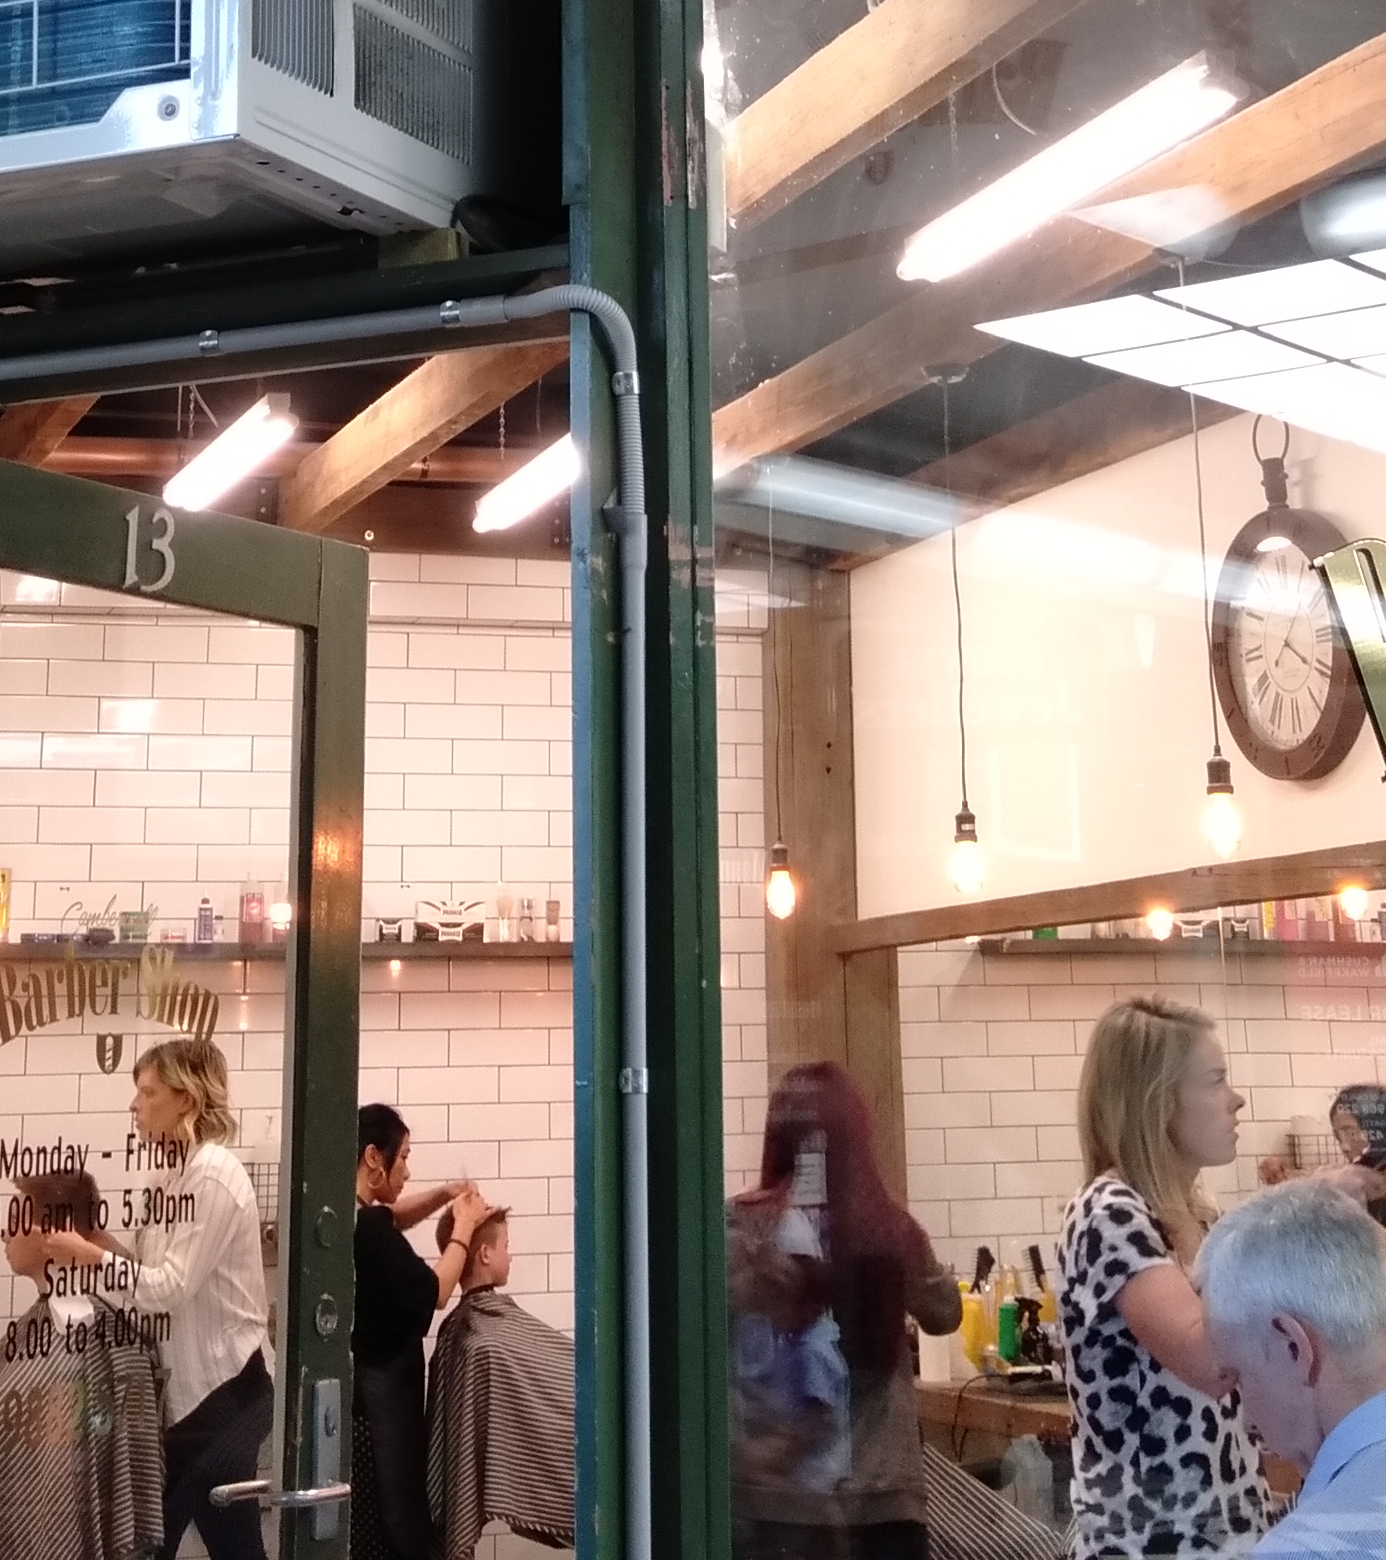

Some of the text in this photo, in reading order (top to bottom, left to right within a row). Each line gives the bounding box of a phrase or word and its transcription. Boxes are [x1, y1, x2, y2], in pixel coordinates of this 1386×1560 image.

[122, 505, 175, 593] 13
[135, 943, 220, 1043] Shop
[125, 1132, 191, 1177] Friday
[41, 1204, 74, 1233] am
[90, 1197, 109, 1231] to
[121, 1187, 196, 1233] 5.30pm
[43, 1253, 142, 1299] Saturday
[5, 1306, 171, 1363] 8.00 to 4.00pm
